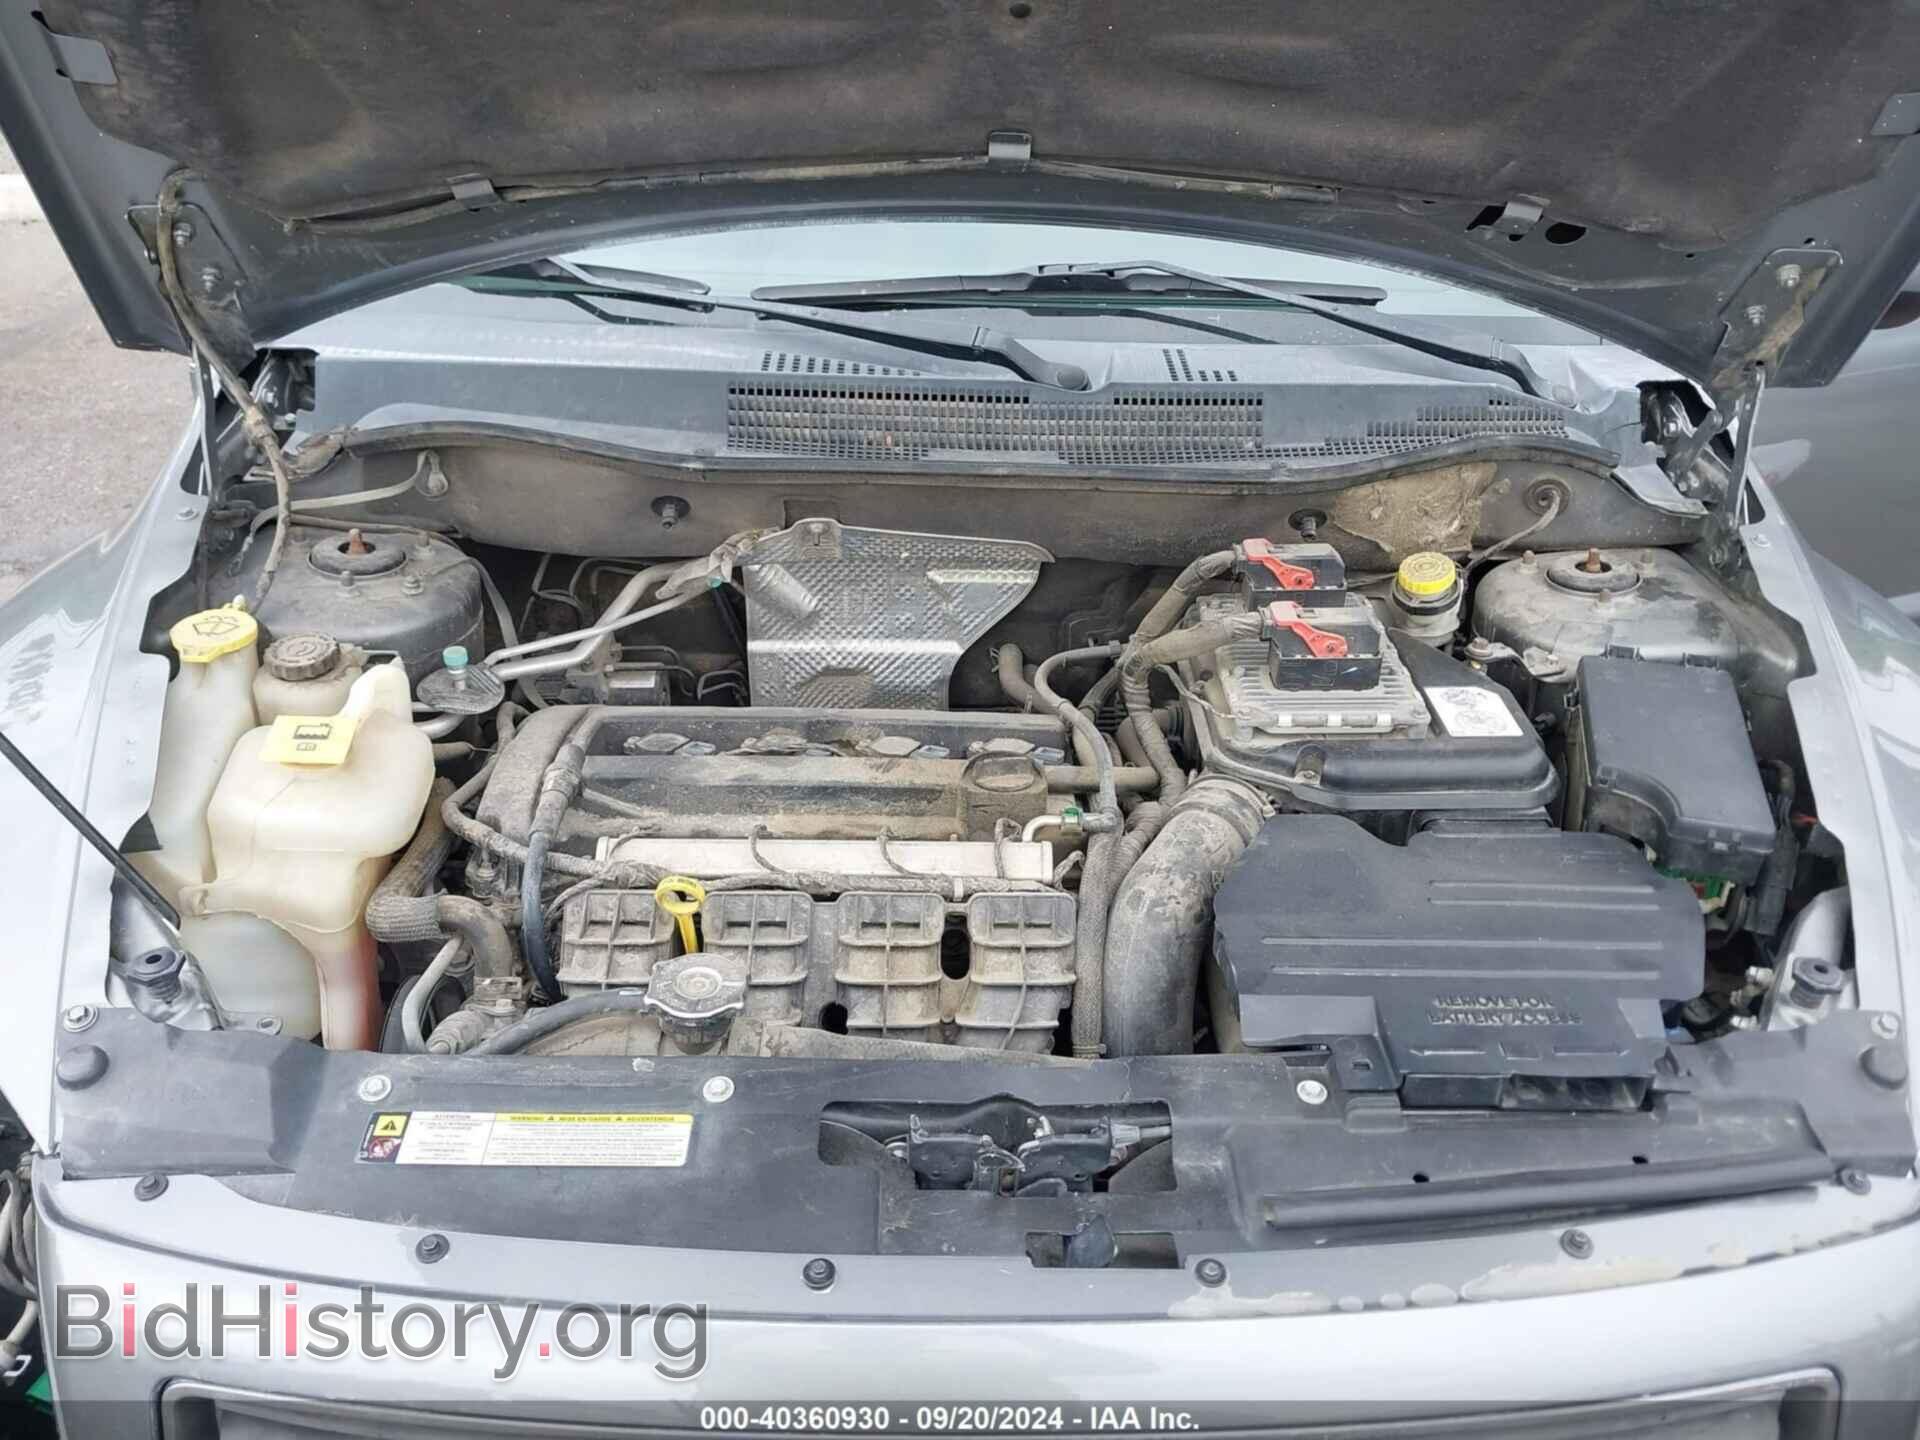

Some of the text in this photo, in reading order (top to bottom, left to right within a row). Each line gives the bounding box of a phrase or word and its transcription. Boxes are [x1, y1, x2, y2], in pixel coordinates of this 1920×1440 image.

[1434, 995, 1555, 1009] REMOVE FOR
[1427, 1009, 1504, 1025] BATTERY
